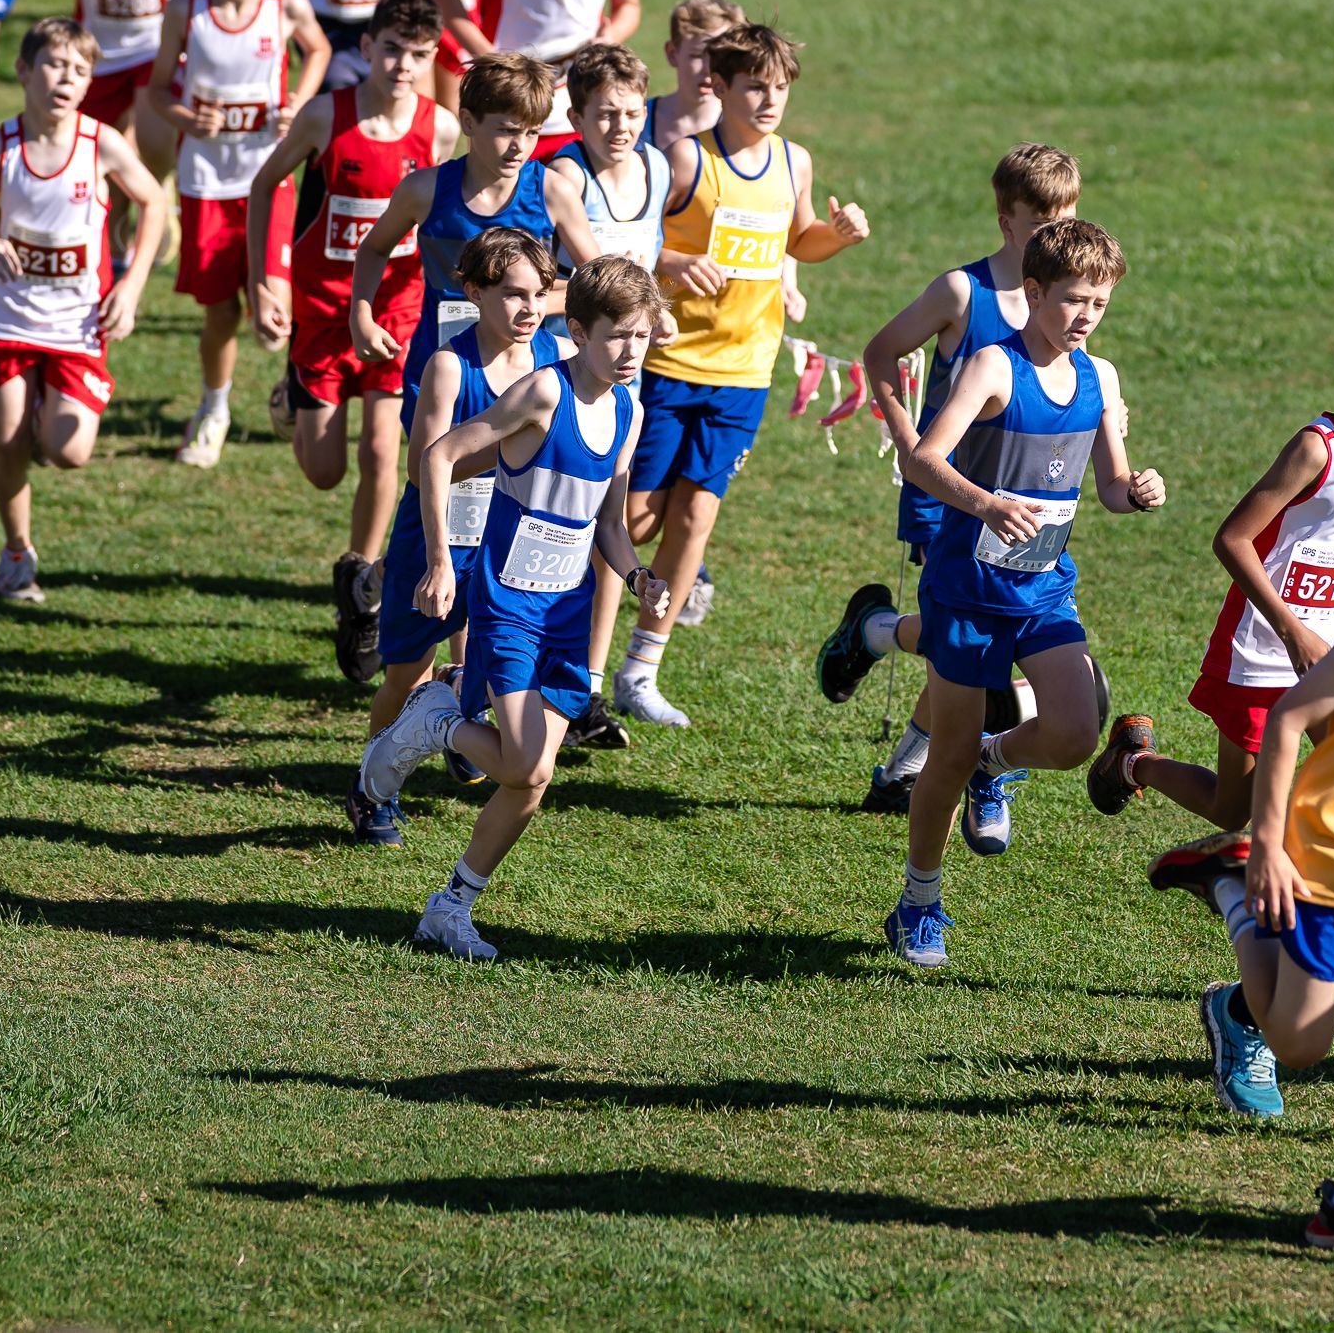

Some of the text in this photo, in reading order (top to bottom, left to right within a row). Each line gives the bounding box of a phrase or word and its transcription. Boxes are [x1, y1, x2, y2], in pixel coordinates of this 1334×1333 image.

[342, 222, 375, 246] 42
[17, 246, 78, 274] 5213
[727, 235, 781, 264] 7216
[447, 306, 462, 314] GPS
[458, 481, 473, 489] GPS
[528, 522, 544, 533] GPS
[510, 538, 526, 573] ACGS
[524, 549, 587, 576] 3207
[1302, 547, 1317, 557] GPS
[1284, 566, 1297, 597] IGS
